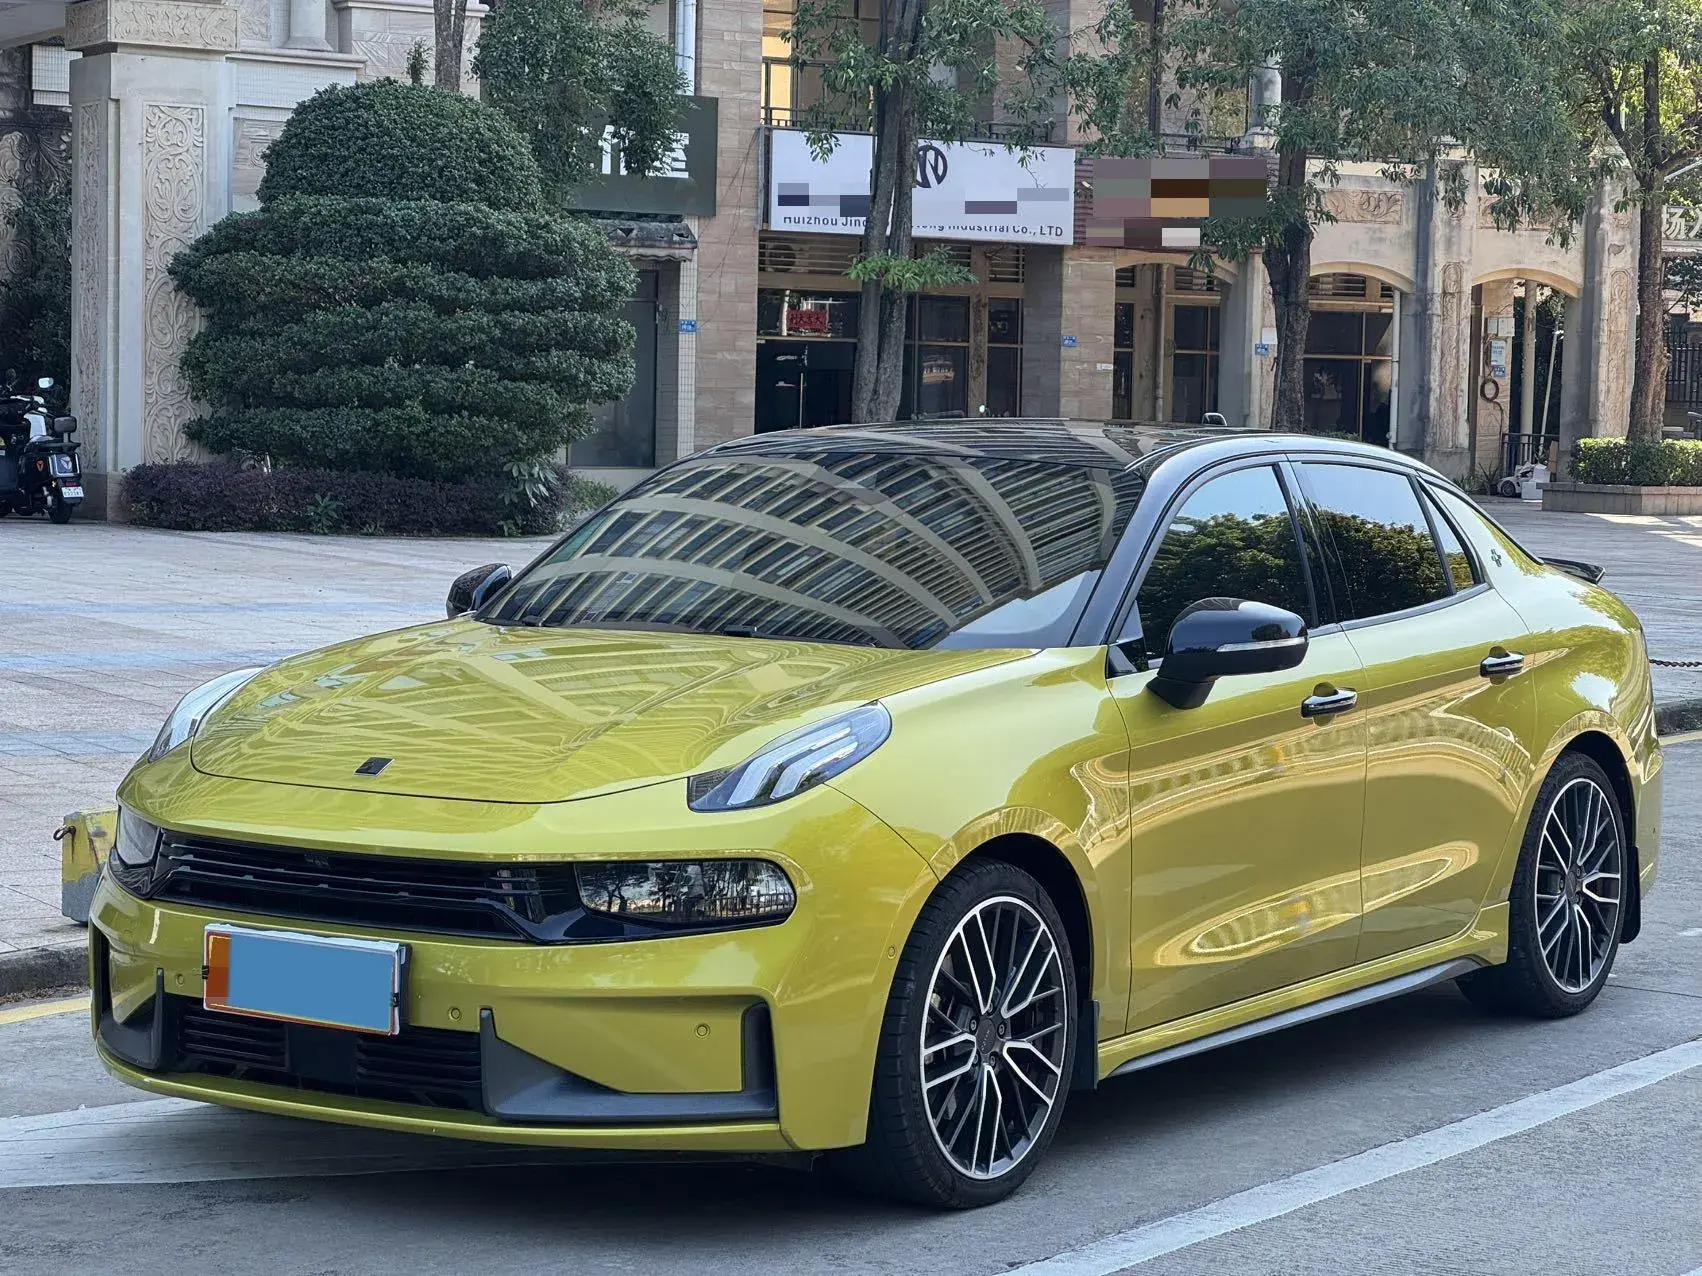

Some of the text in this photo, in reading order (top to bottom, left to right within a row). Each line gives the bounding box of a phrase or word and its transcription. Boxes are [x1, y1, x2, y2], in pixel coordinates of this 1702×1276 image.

[783, 216, 838, 226] Huizhou
[1012, 225, 1036, 236] Co.,
[1040, 226, 1063, 236] LTD
